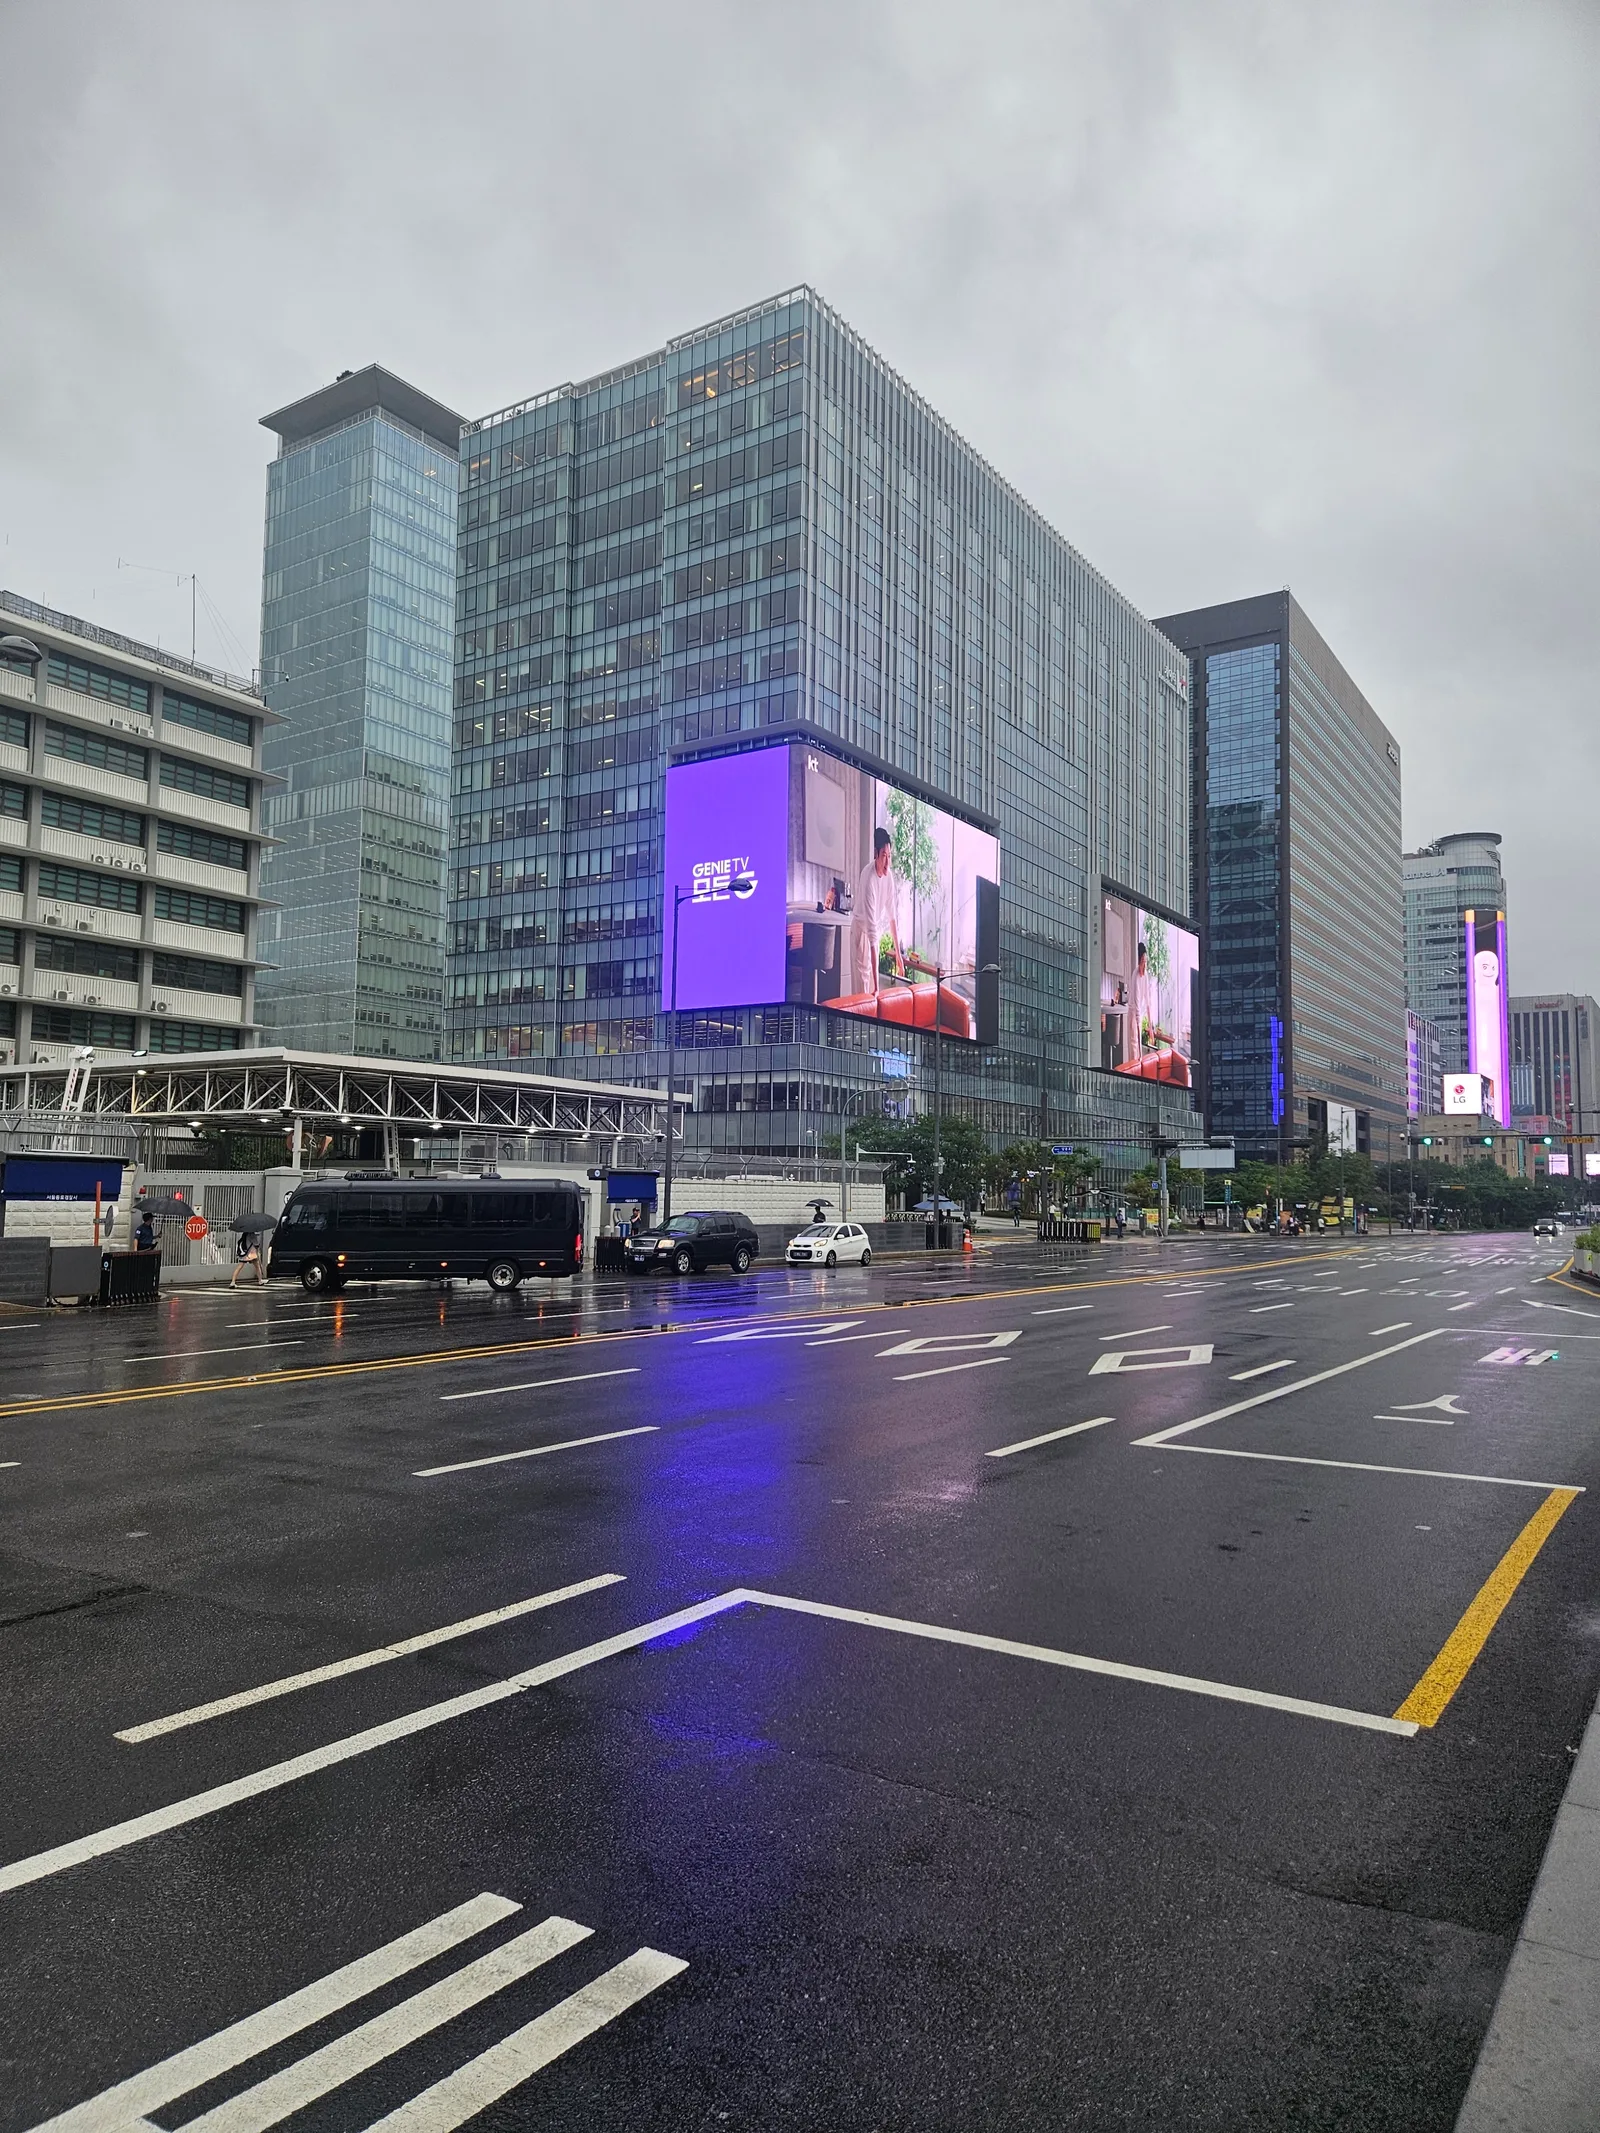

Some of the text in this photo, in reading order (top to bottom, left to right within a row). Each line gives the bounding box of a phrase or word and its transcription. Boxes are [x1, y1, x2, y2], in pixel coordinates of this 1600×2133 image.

[807, 754, 819, 773] kt
[692, 856, 750, 877] GENIE TV
[1105, 898, 1112, 911] kt
[1452, 1095, 1466, 1104] LG
[186, 1223, 207, 1234] STOP
[1254, 1283, 1342, 1293] 50
[1379, 1288, 1470, 1298] 50
